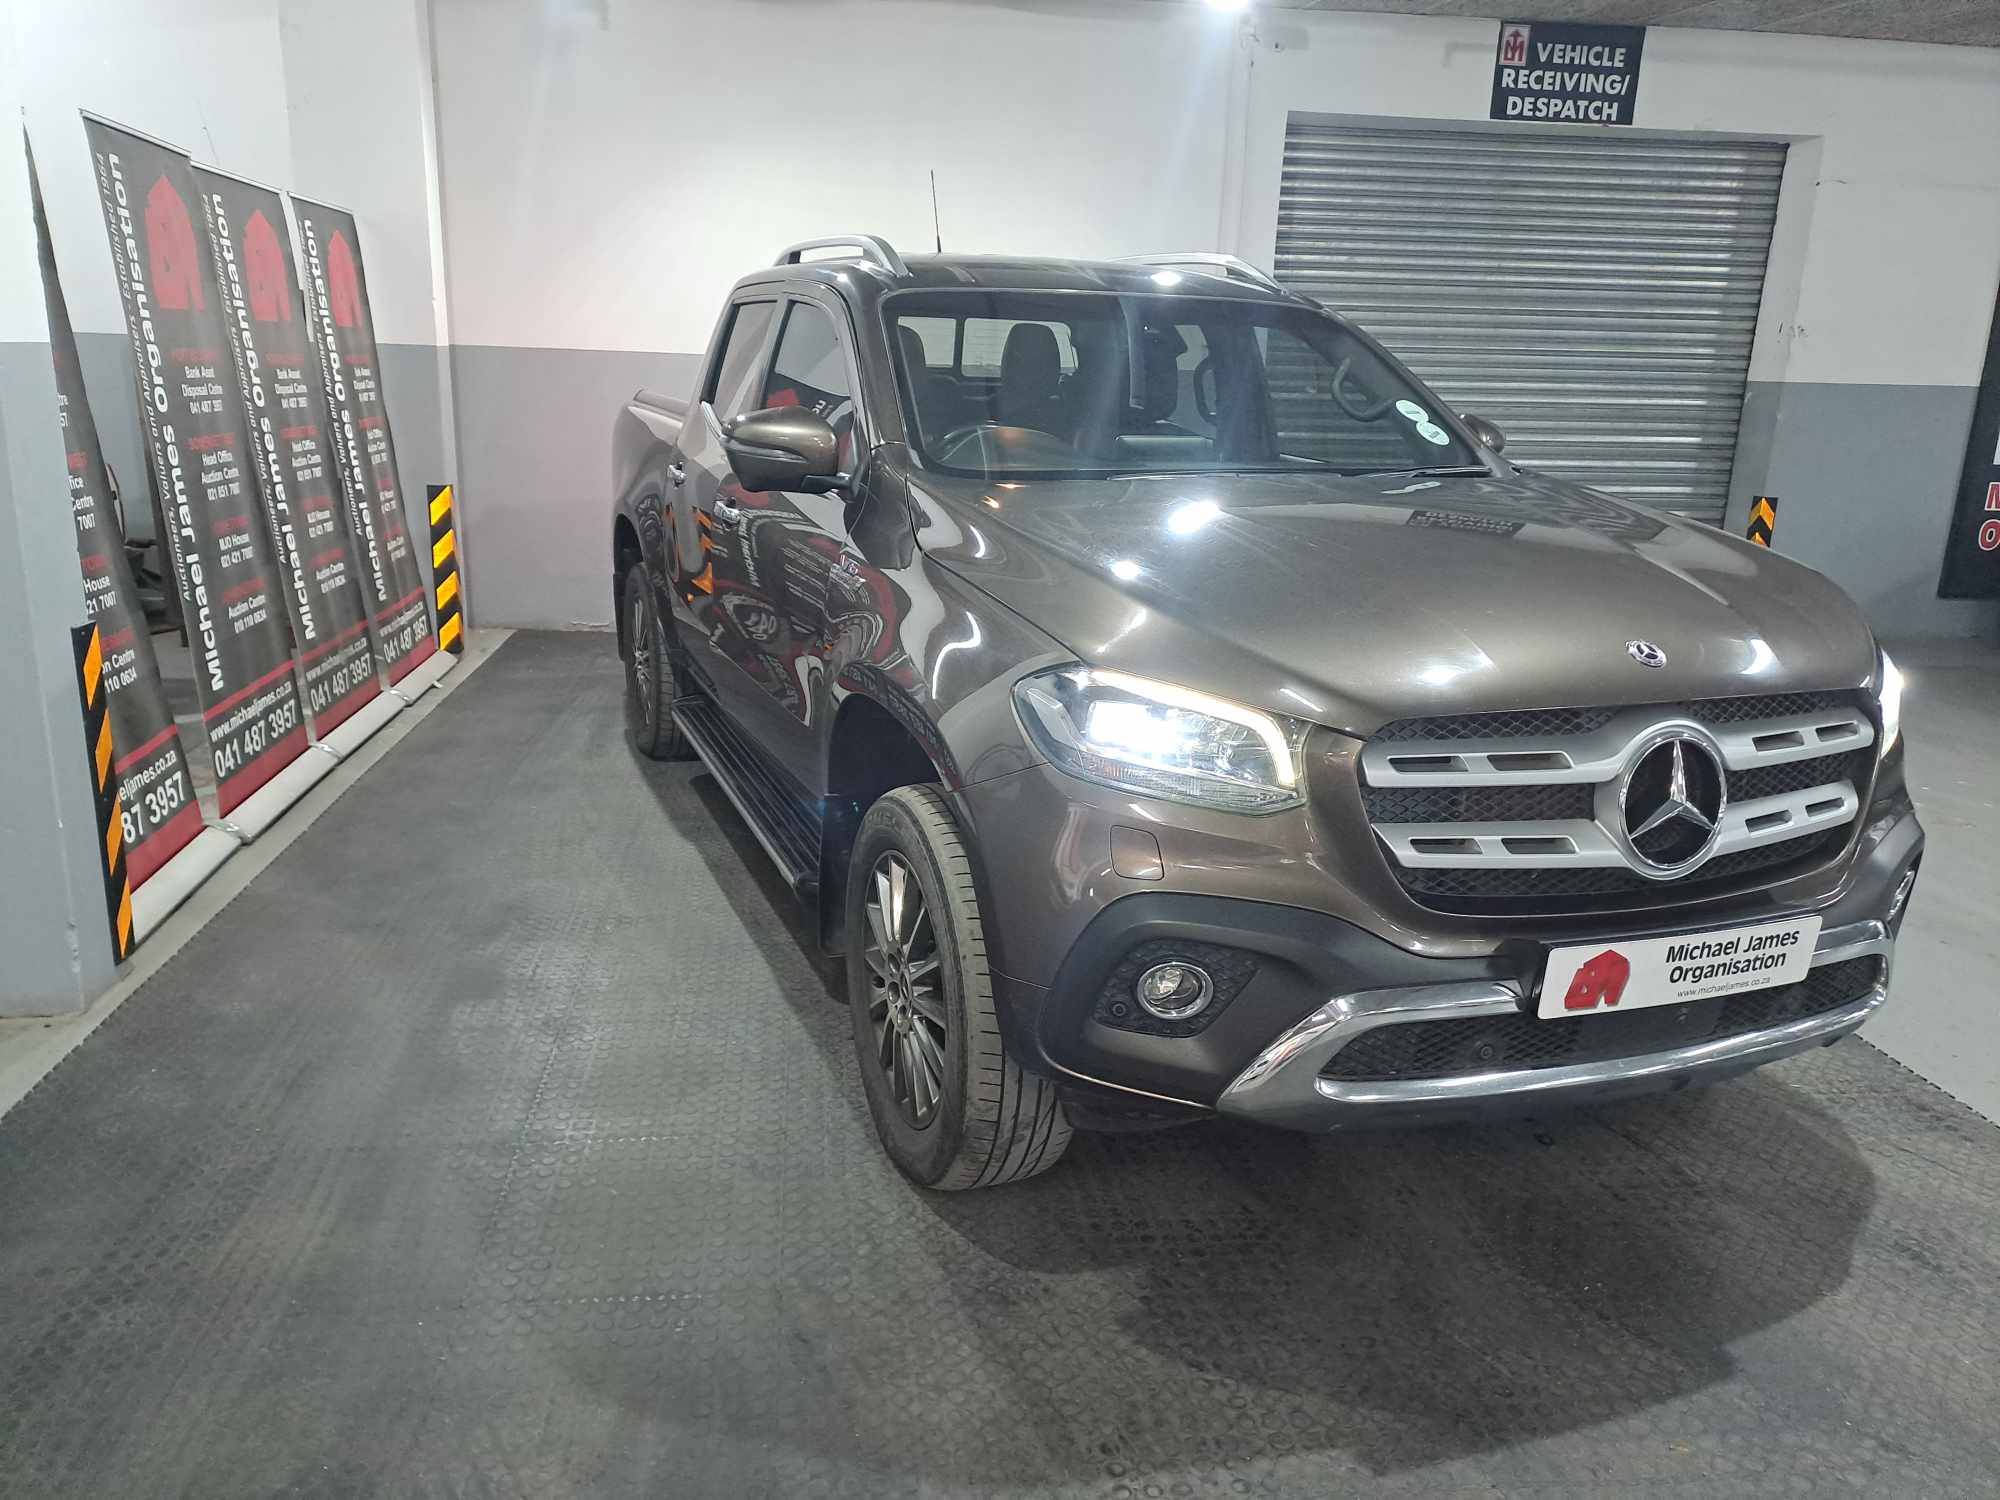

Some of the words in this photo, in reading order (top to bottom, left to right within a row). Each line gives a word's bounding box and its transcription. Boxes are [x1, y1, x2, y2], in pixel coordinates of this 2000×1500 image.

[1501, 68, 1631, 96] RECEIVING/
[1537, 42, 1626, 68] VEHICLE
[1506, 96, 1619, 122] DESPATCH
[104, 200, 131, 300] Established
[108, 153, 168, 413] Organisation
[212, 194, 265, 407] Organisation
[304, 220, 345, 402] Organisation
[129, 315, 152, 403] Appraisers
[146, 405, 159, 437] and
[245, 400, 256, 427] and
[327, 396, 337, 418] and
[155, 442, 171, 500] Valuers
[253, 431, 268, 479] Valuers
[260, 417, 289, 516] James
[341, 409, 365, 494] James
[163, 424, 196, 543] James
[359, 502, 387, 602] Michael
[83, 575, 111, 593] House
[87, 598, 99, 615] 21
[281, 524, 316, 640] Michael
[186, 553, 224, 691] Michael
[383, 637, 400, 663] 041
[111, 648, 135, 668] Centre
[310, 680, 332, 712] 041
[332, 666, 351, 697] 487
[350, 652, 372, 684] 3957
[214, 738, 242, 778] 041
[244, 720, 266, 756] 487
[268, 699, 296, 738] 3957
[119, 749, 177, 802] eljames.co.za
[120, 801, 143, 844] 87
[145, 770, 185, 825] 3957
[1665, 936, 1741, 963] Michael
[1743, 930, 1800, 953] James
[1669, 952, 1786, 984] Organisation
